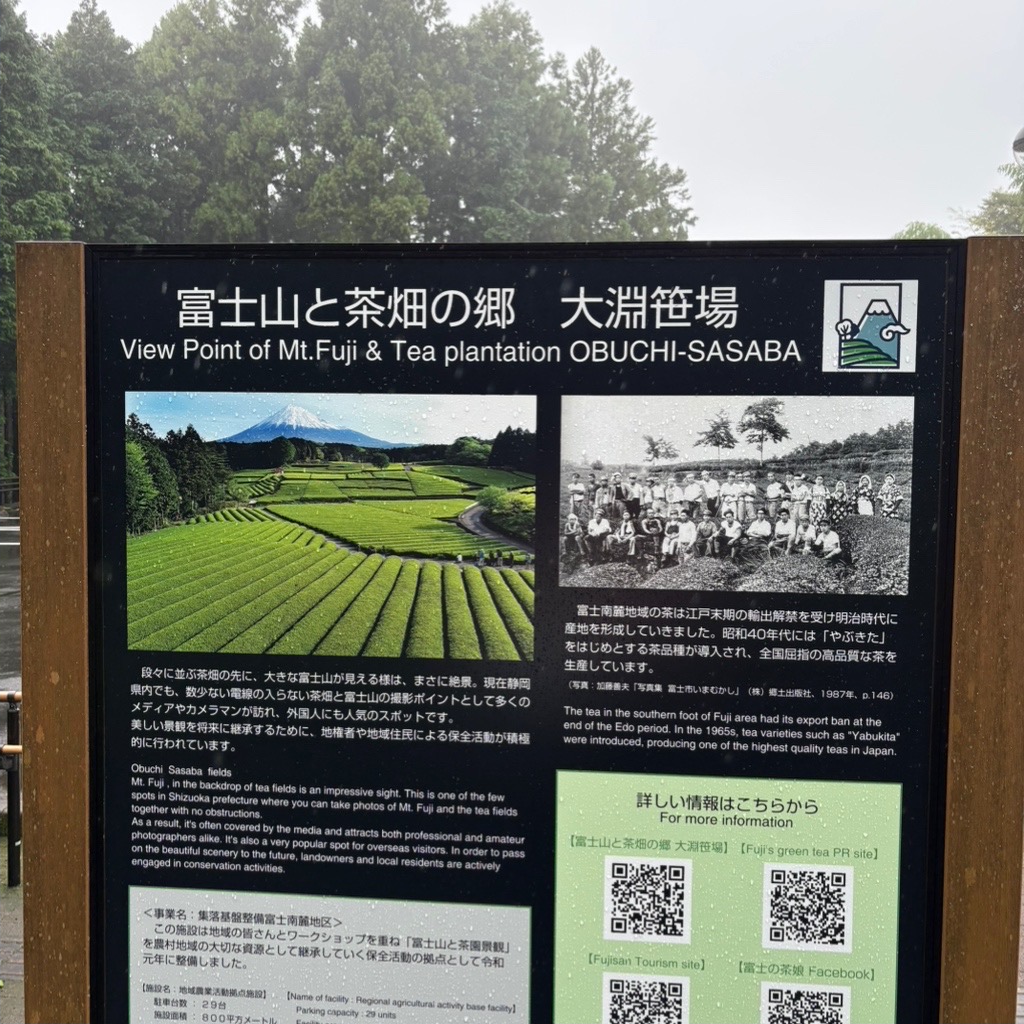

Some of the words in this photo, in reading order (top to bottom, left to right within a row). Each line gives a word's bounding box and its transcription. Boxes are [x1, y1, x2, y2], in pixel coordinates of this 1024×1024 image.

[176, 286, 516, 329] 富士山と茶畑の郷
[560, 285, 740, 330] 大淵笹場
[120, 339, 176, 360] View
[183, 338, 242, 360] Point
[249, 339, 271, 360] of
[278, 338, 358, 367] Mt.Fuji
[365, 340, 383, 361] &
[390, 340, 437, 362] Tea
[445, 341, 561, 366] plantation
[569, 340, 802, 363] OBUCHI-SASABA
[563, 705, 583, 716] The
[585, 707, 601, 717] tea
[603, 707, 613, 717] in
[615, 708, 631, 718] the
[633, 710, 677, 720] southern
[679, 710, 699, 721] foot
[700, 711, 711, 721] of
[713, 711, 732, 724] Fuji
[734, 714, 758, 723] area
[760, 714, 780, 724] had
[782, 714, 794, 725] its
[796, 716, 829, 726] export
[831, 716, 851, 726] ban
[853, 717, 863, 727] at
[865, 717, 882, 727] the
[563, 721, 583, 730] end
[584, 721, 595, 731] of
[596, 722, 613, 731] the
[615, 721, 635, 732] Edo
[637, 724, 671, 734] period.
[674, 724, 684, 734] In
[686, 725, 703, 735] the
[706, 726, 739, 737] 1965s,
[741, 728, 758, 737] tea
[760, 729, 803, 739] varieties
[805, 730, 830, 740] such
[832, 732, 845, 740] as
[847, 731, 901, 742] "Yabukita"
[563, 736, 588, 745] were
[589, 736, 644, 747] introduced,
[647, 739, 696, 751] producing
[698, 741, 718, 750] one
[720, 740, 731, 750] of
[732, 741, 749, 751] the
[751, 742, 788, 754] highest
[790, 744, 824, 756] quality
[826, 745, 849, 755] teas
[851, 745, 860, 755] in
[862, 746, 897, 757] Japan.
[130, 763, 164, 774] Obuchi
[168, 765, 203, 776] Sasaba
[207, 767, 232, 778] fields
[131, 777, 145, 787] Mt.
[148, 778, 165, 790] Fuji
[172, 779, 181, 788] in
[182, 779, 198, 789] the
[199, 781, 242, 793] backdrop
[243, 782, 253, 792] of
[255, 783, 270, 793] tea
[272, 783, 297, 794] fields
[299, 785, 308, 795] is
[309, 786, 322, 795] an
[323, 786, 375, 797] impressive
[376, 788, 401, 800] sight.
[404, 788, 425, 799] This
[427, 790, 436, 800] is
[437, 792, 457, 801] one
[458, 791, 468, 801] of
[470, 792, 486, 802] the
[487, 792, 506, 802] few
[131, 804, 169, 815] together
[170, 806, 189, 815] with
[191, 808, 204, 816] no
[205, 808, 263, 819] obstructions.
[636, 793, 819, 815] 詳しい情報はこちらから
[131, 817, 144, 827] As
[145, 819, 152, 827] a
[154, 819, 182, 829] result,
[184, 819, 197, 829] it's
[198, 820, 222, 830] often
[223, 823, 261, 832] covered
[262, 823, 275, 835] by
[276, 824, 292, 834] the
[293, 826, 323, 835] media
[324, 827, 343, 836] and
[344, 828, 380, 838] attracts
[381, 829, 403, 839] both
[404, 831, 463, 842] professional
[464, 833, 483, 843] and
[485, 835, 526, 844] amateur
[660, 811, 682, 824] For
[685, 815, 718, 826] more
[722, 814, 794, 828] information
[131, 845, 144, 853] on
[145, 844, 160, 854] the
[161, 845, 201, 856] beautiful
[202, 848, 239, 859] scenery
[240, 849, 250, 859] to
[251, 850, 267, 859] the
[268, 850, 298, 861] future,
[300, 852, 355, 864] landowners
[356, 856, 375, 865] and
[376, 856, 399, 866] local
[401, 858, 445, 868] residents
[446, 860, 463, 869] are
[464, 861, 501, 873] actively
[131, 858, 171, 869] engaged
[173, 858, 182, 868] in
[183, 861, 242, 871] conservation
[243, 863, 286, 873] activities.
